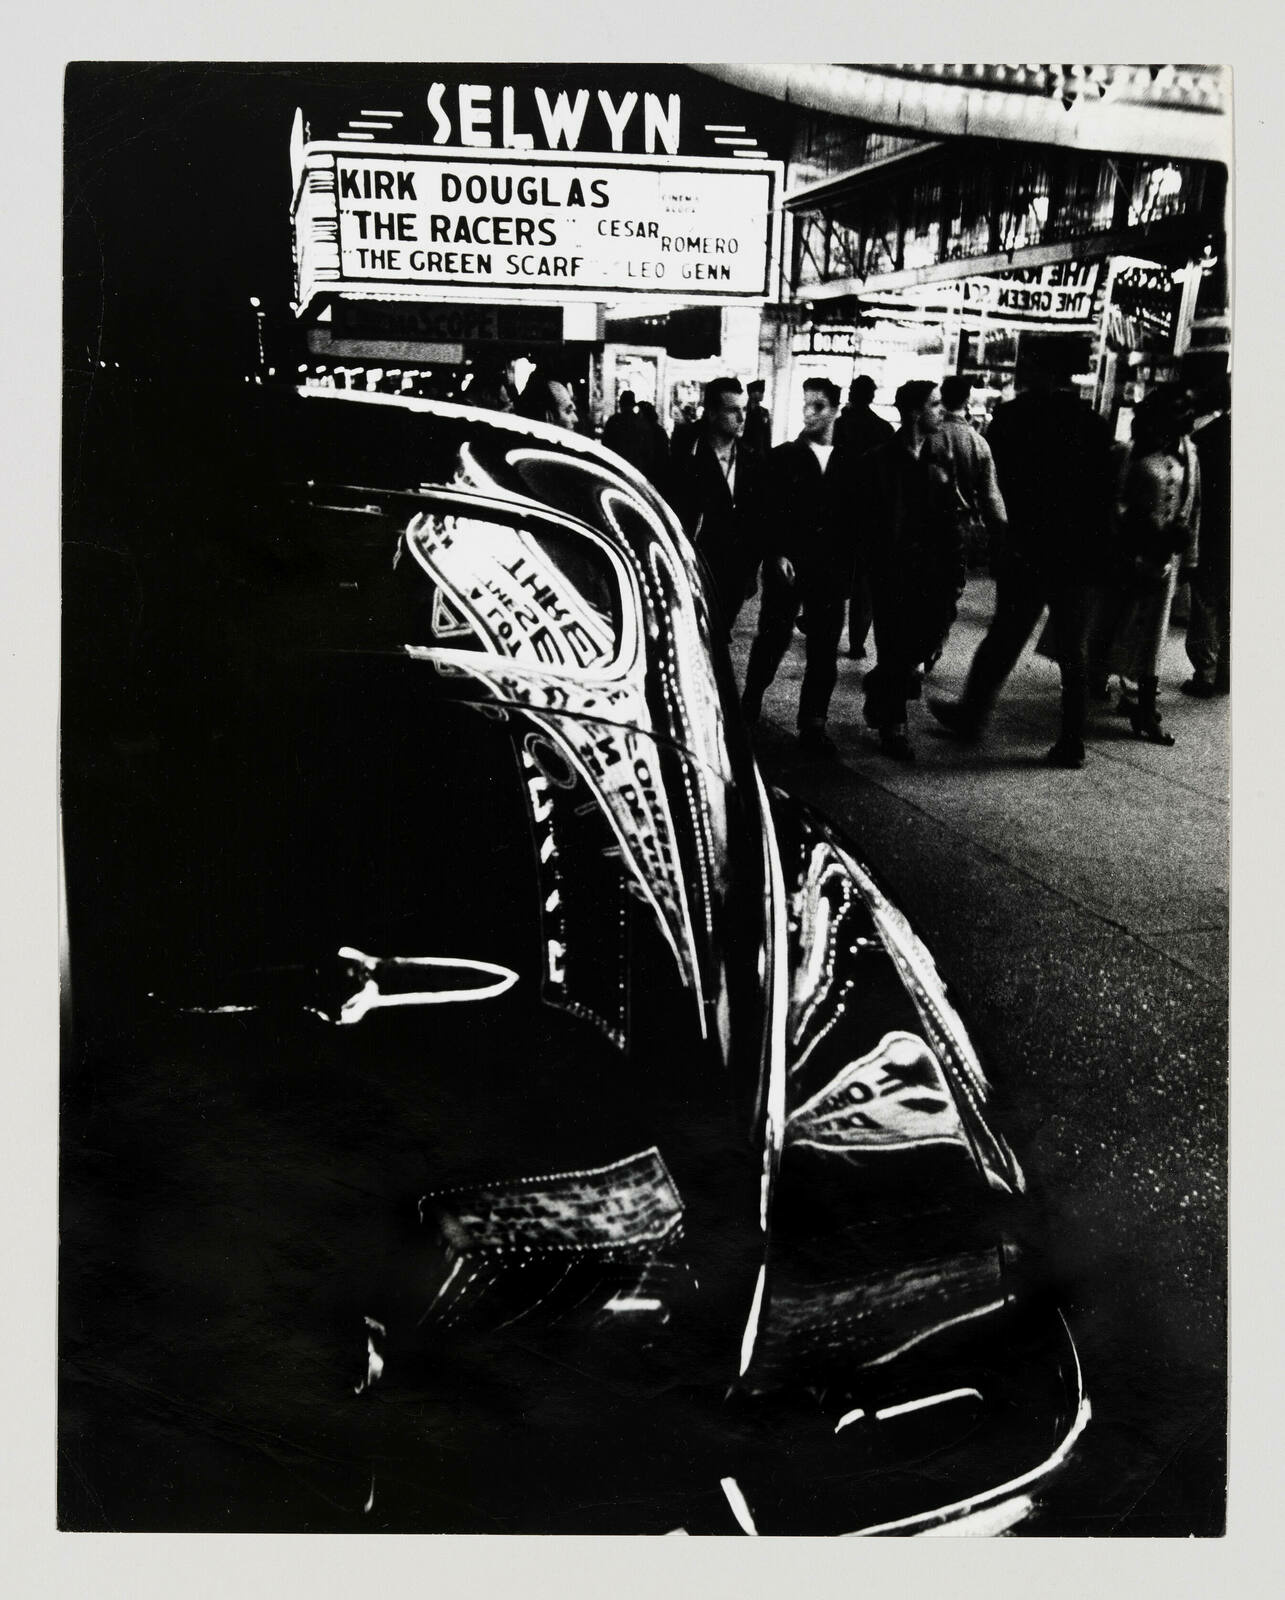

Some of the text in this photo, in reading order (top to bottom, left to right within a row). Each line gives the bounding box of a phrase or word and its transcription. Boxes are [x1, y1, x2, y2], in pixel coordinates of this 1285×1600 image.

[427, 82, 680, 154] SELWYN
[340, 168, 610, 208] KIRK DOUGLAS
[597, 219, 660, 239] CESAR
[661, 235, 739, 254] ROMERO
[409, 250, 493, 274] GREEN
[627, 260, 665, 278] LEO
[681, 262, 731, 280] GENN
